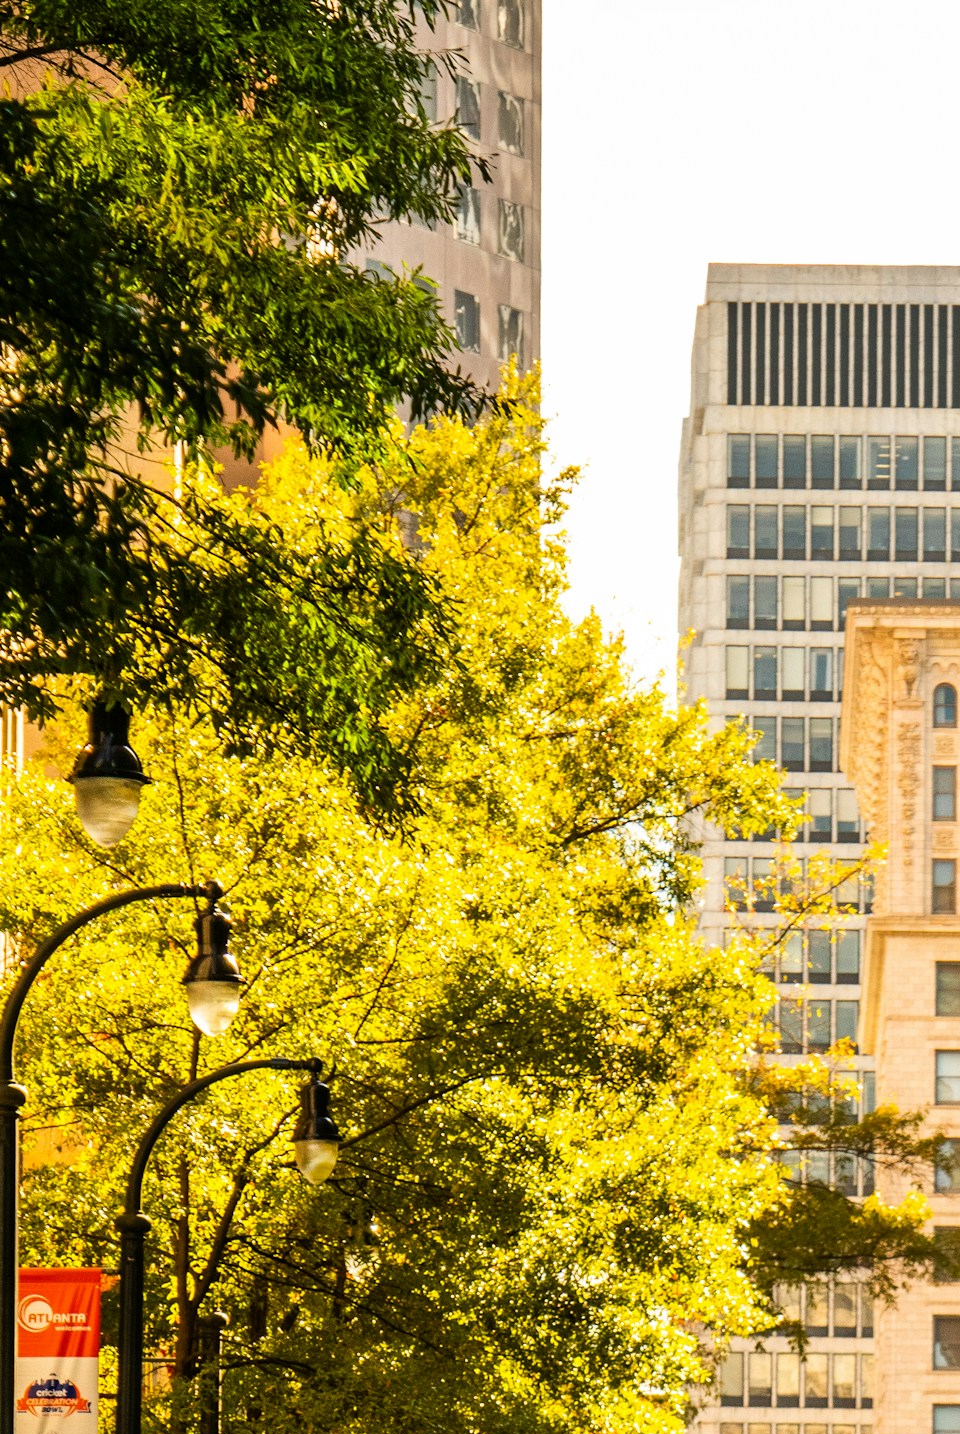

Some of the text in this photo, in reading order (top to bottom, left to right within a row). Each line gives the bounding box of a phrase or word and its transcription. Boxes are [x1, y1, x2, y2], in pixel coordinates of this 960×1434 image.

[28, 1313, 86, 1323] ATLANTA
[36, 1388, 67, 1397] cricket
[26, 1398, 78, 1406] CELEBRATION
